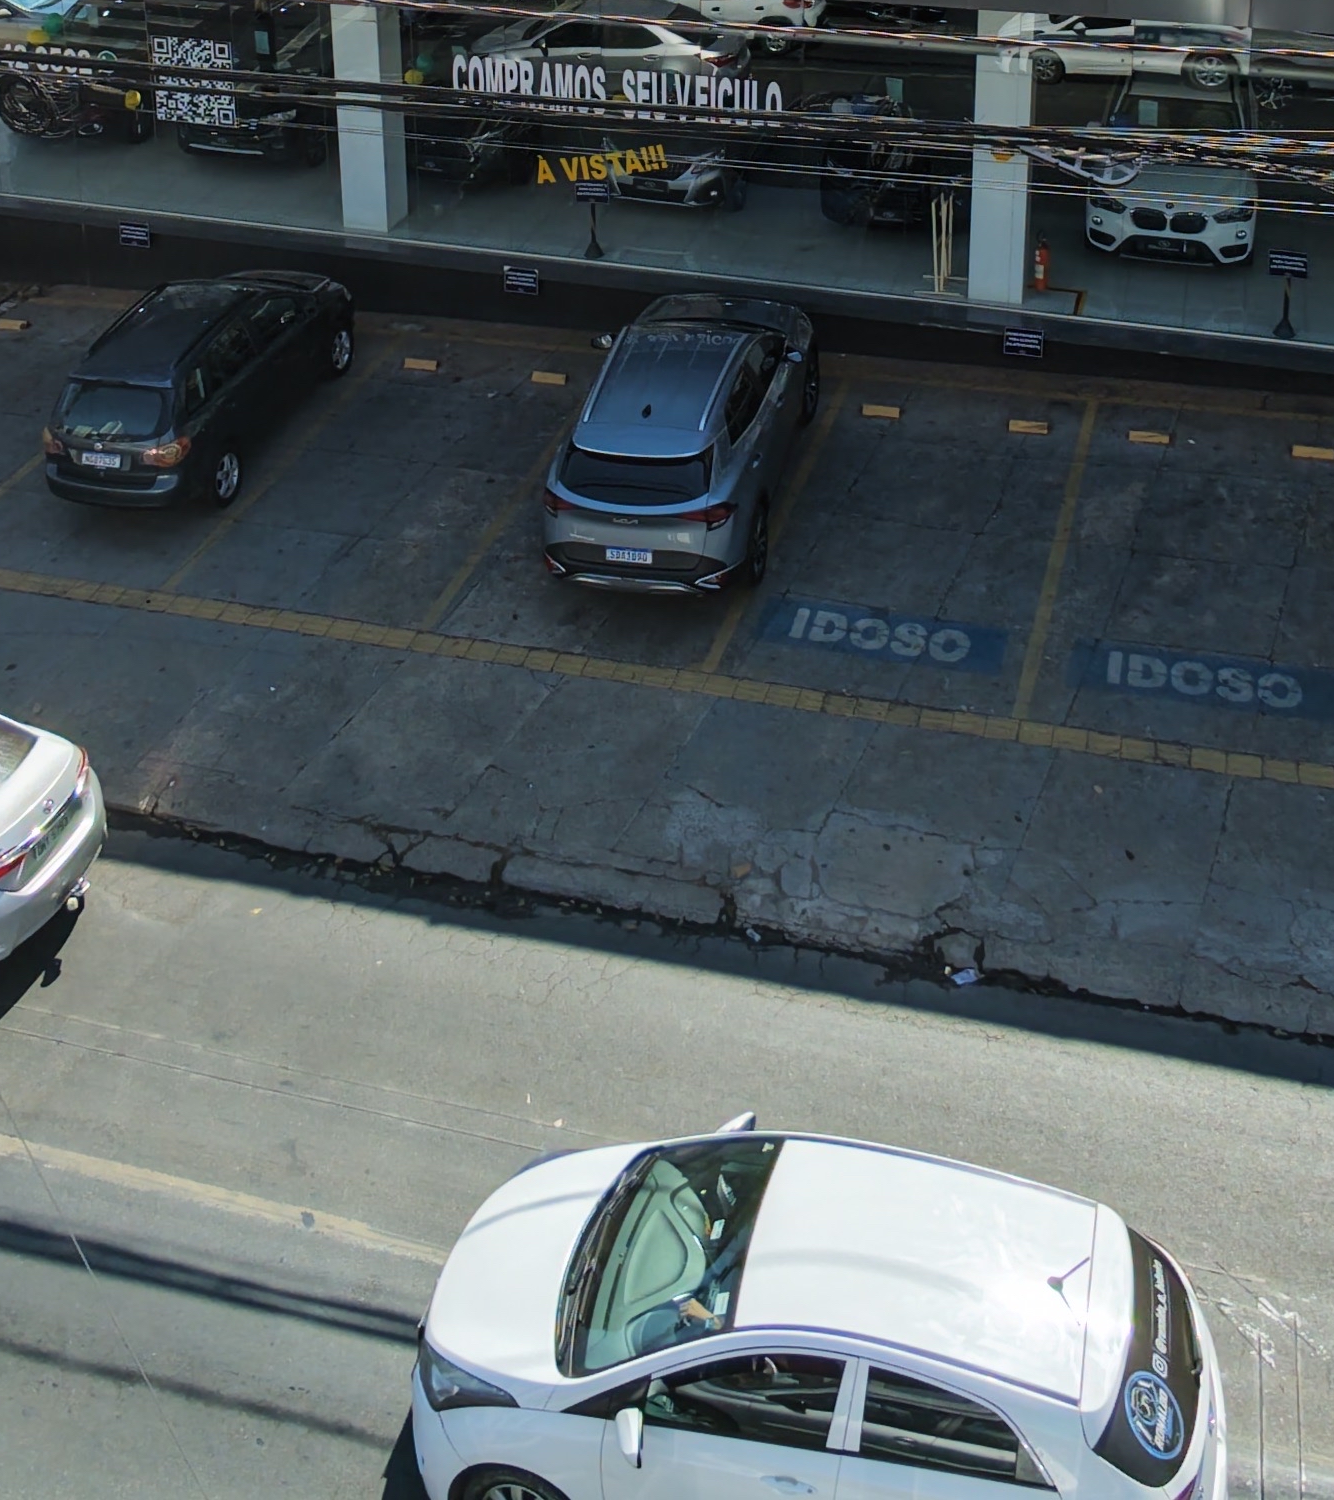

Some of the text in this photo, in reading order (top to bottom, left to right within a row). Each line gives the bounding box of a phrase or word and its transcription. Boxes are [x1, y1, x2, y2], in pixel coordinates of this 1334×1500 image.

[452, 53, 606, 115] COMPRAMOS
[622, 68, 667, 120] SEU
[537, 154, 557, 185] À
[788, 607, 972, 662] IDOSO
[1107, 650, 1303, 709] IDOSO
